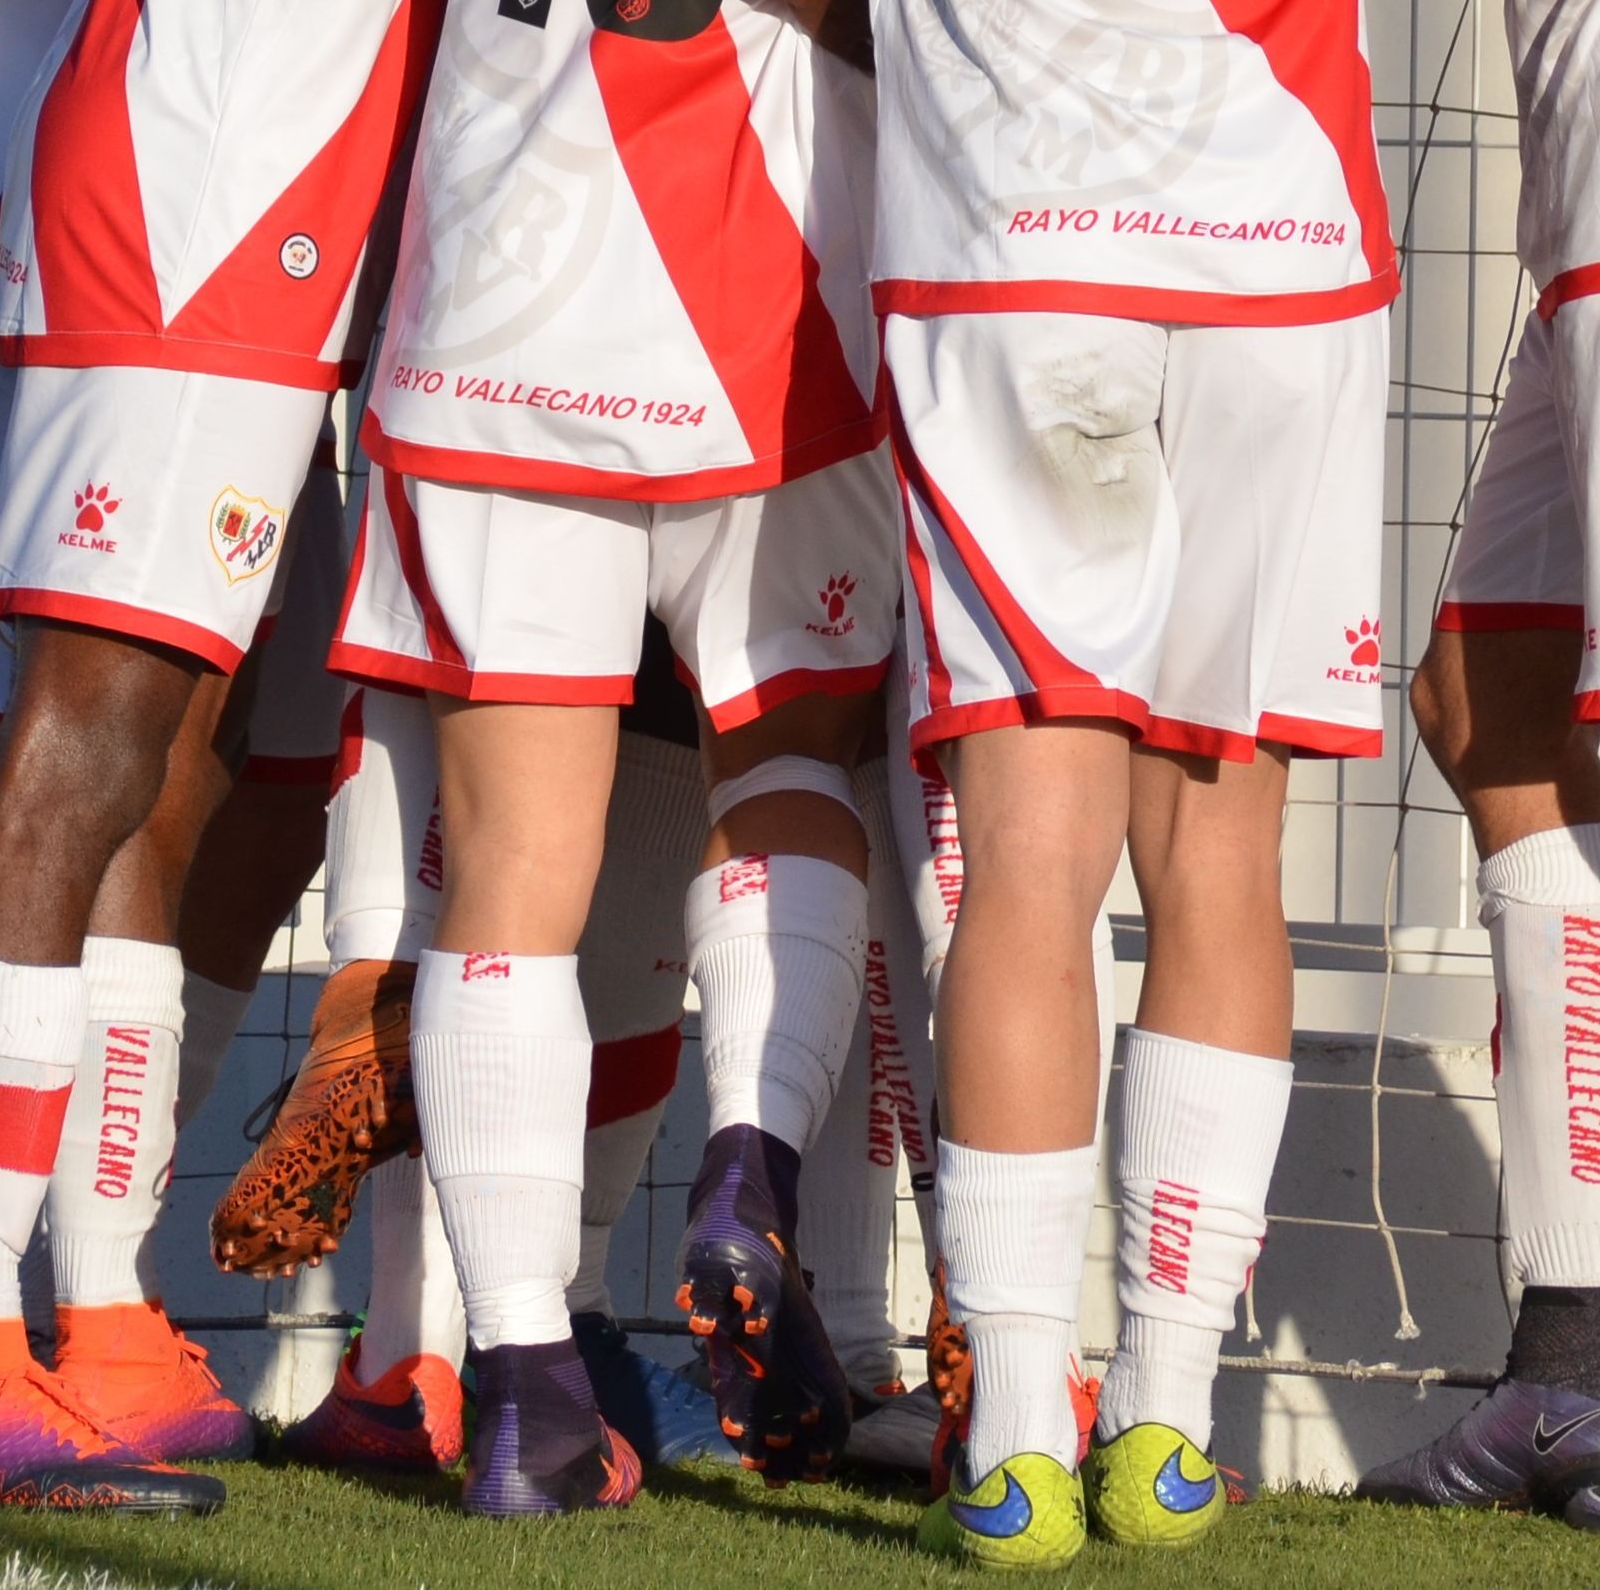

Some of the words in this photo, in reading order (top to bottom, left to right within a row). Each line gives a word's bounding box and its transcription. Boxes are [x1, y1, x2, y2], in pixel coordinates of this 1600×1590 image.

[1007, 209, 1099, 234] RAYO
[1112, 210, 1296, 242] VALLECANO
[1300, 221, 1346, 246] 1924
[391, 365, 444, 394] RAYO
[454, 375, 637, 420] VALLECANO
[641, 401, 707, 427] 1924
[58, 533, 117, 553] KELME
[94, 1027, 150, 1199] VALLECANO
